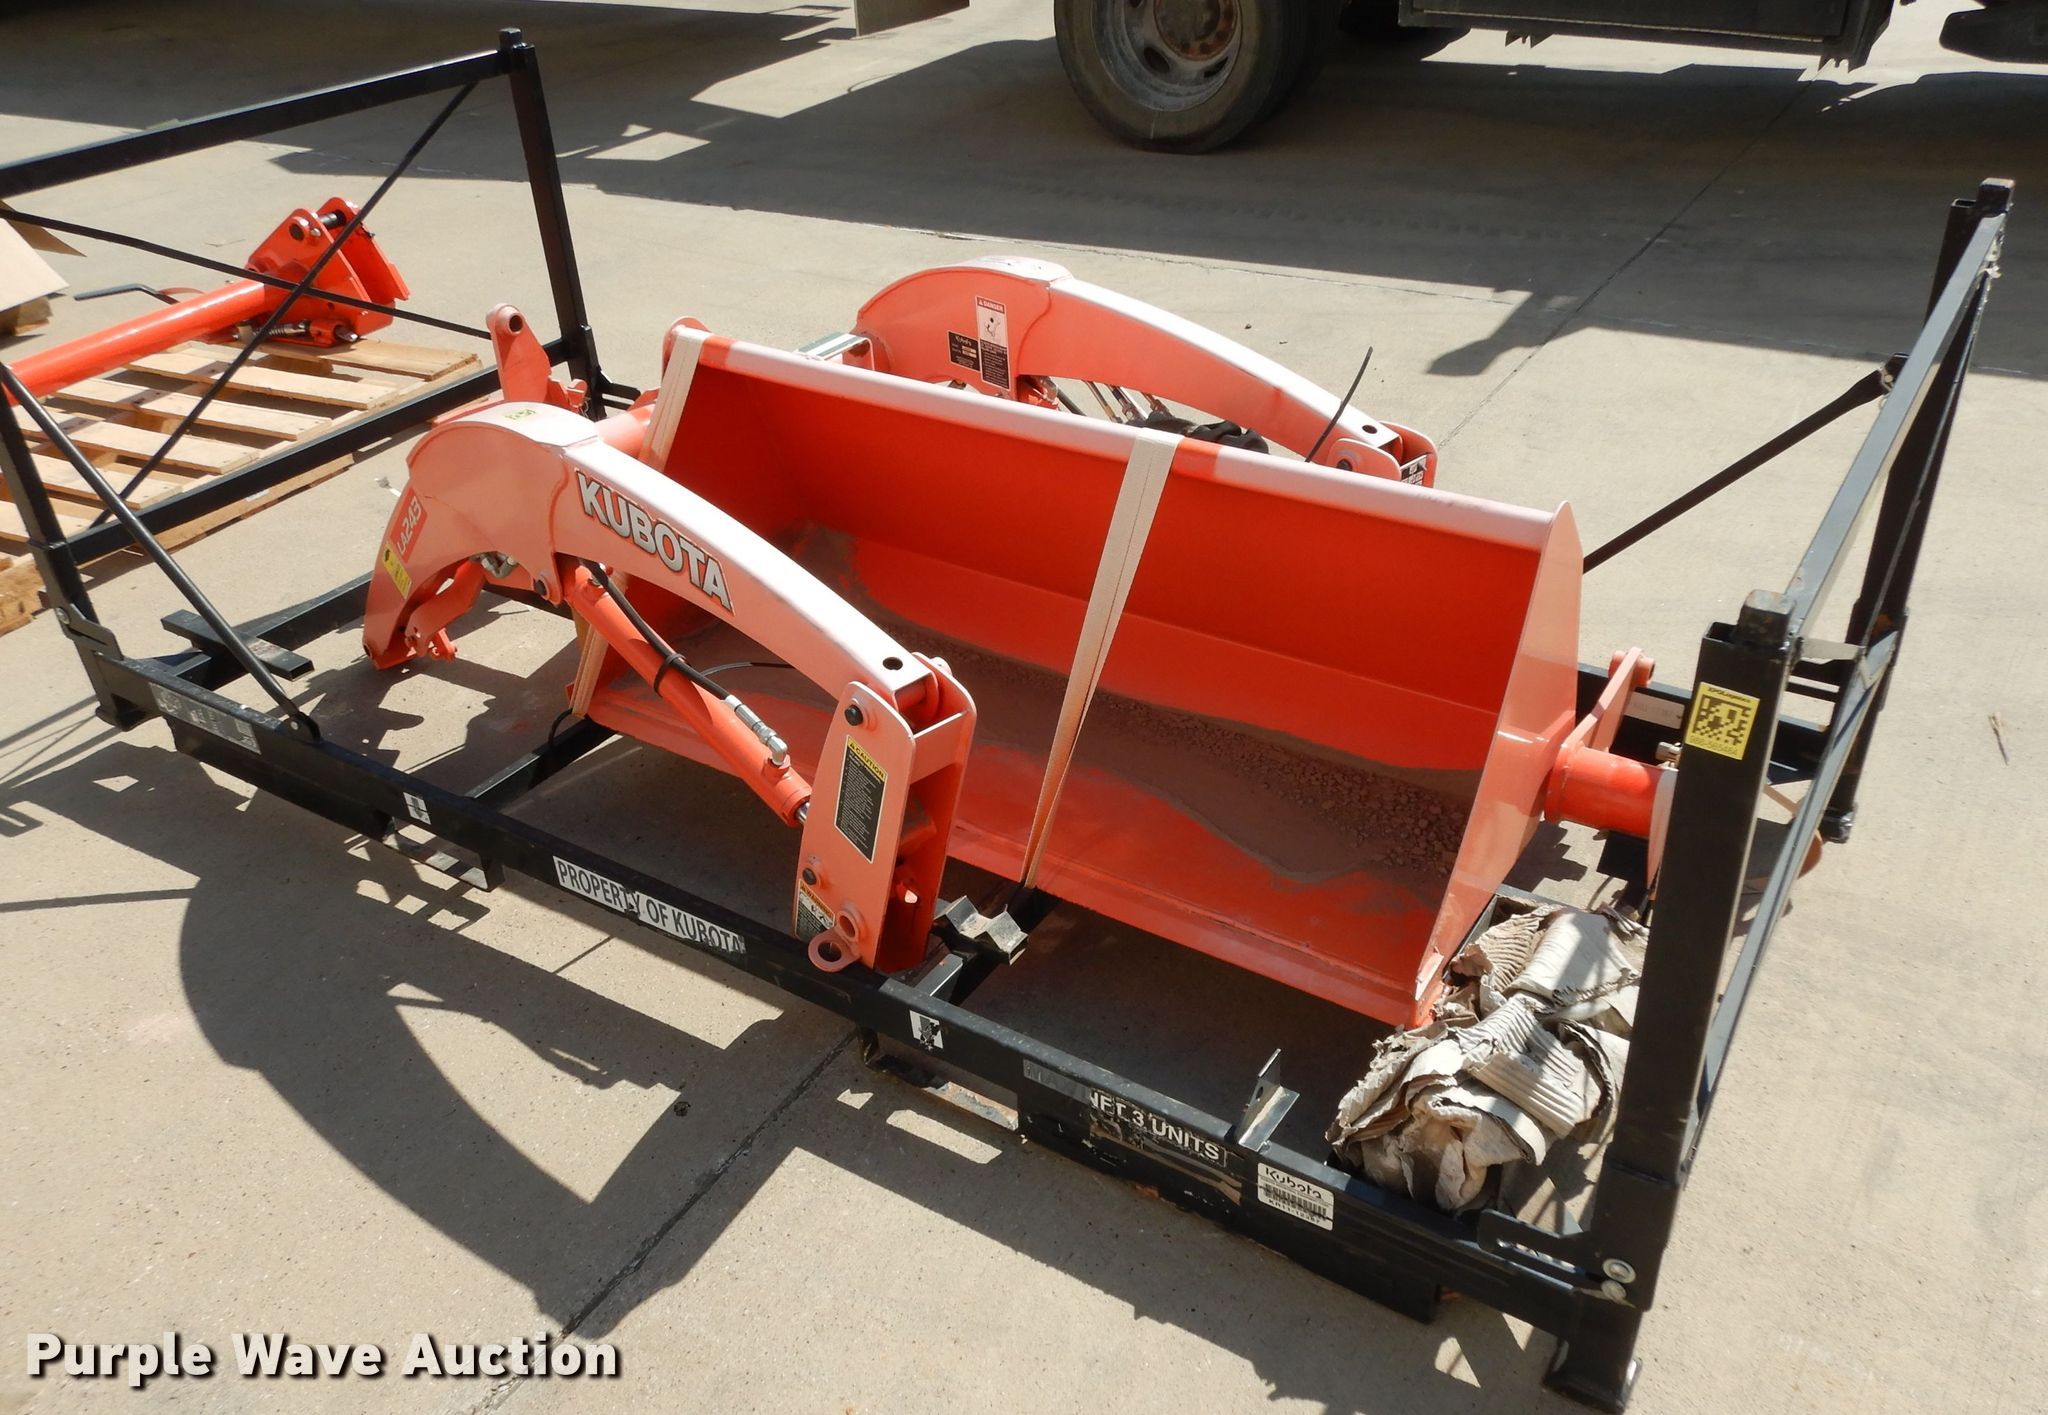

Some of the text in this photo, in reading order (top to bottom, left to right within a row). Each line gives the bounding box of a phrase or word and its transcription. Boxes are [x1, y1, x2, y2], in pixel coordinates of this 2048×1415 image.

[396, 495, 422, 555] LA243
[576, 470, 734, 614] KUBOTA
[856, 747, 884, 778] CAUTION
[557, 859, 642, 915] PROPERTY
[646, 898, 669, 927] OF
[672, 908, 746, 954] KUBOTA
[1132, 1110, 1145, 1128] 3
[1152, 1117, 1220, 1160] UNITS
[1265, 1167, 1322, 1199] Kubota
